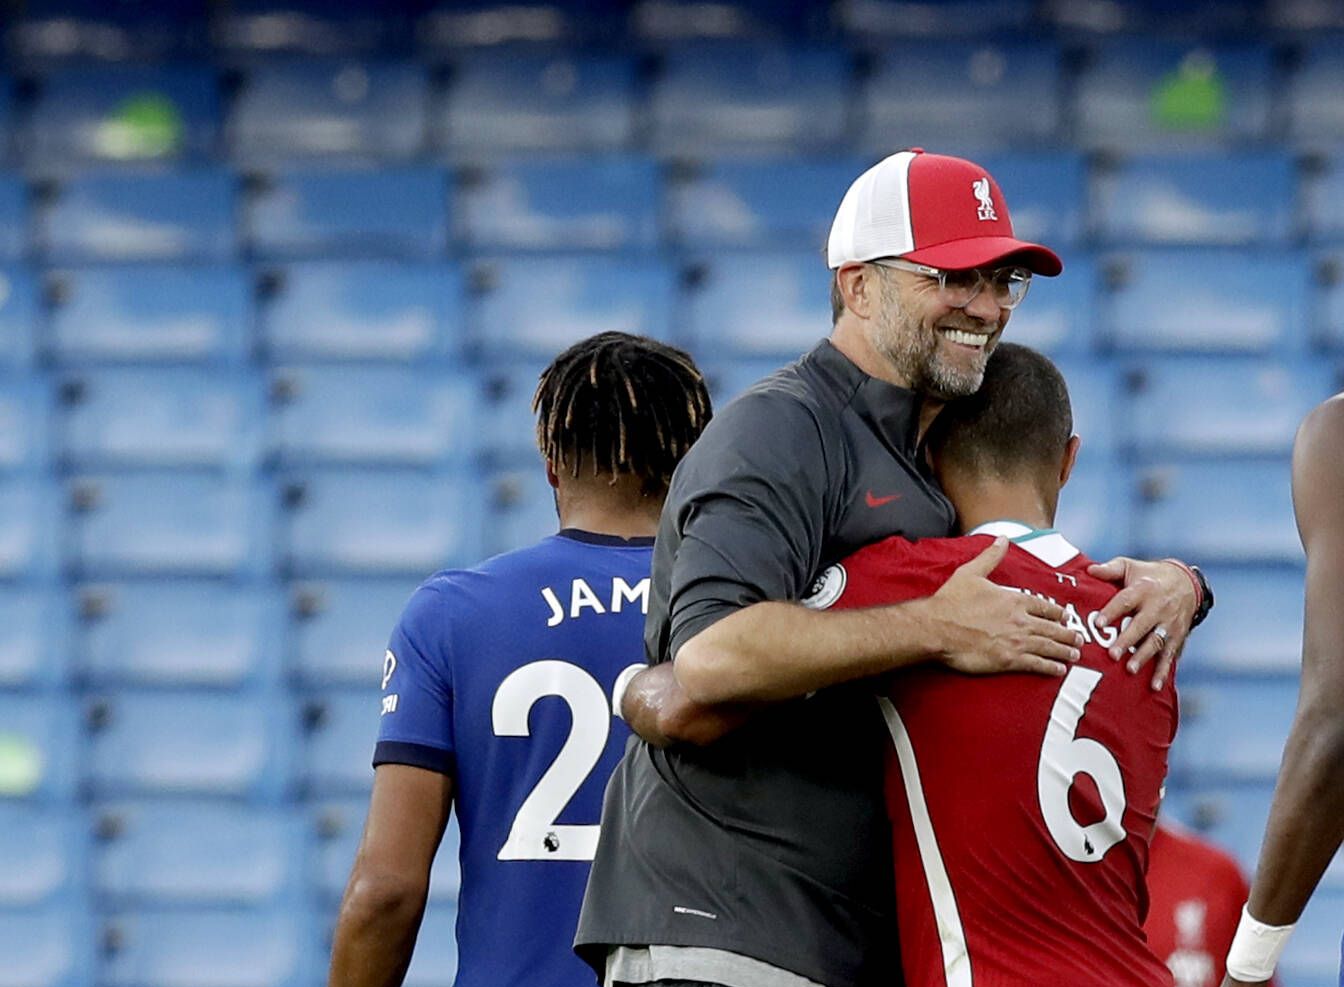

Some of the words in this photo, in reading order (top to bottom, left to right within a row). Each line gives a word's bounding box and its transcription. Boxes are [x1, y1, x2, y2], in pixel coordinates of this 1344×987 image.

[541, 577, 652, 627] JAM
[491, 659, 649, 861] 2
[1038, 665, 1128, 863] 6
